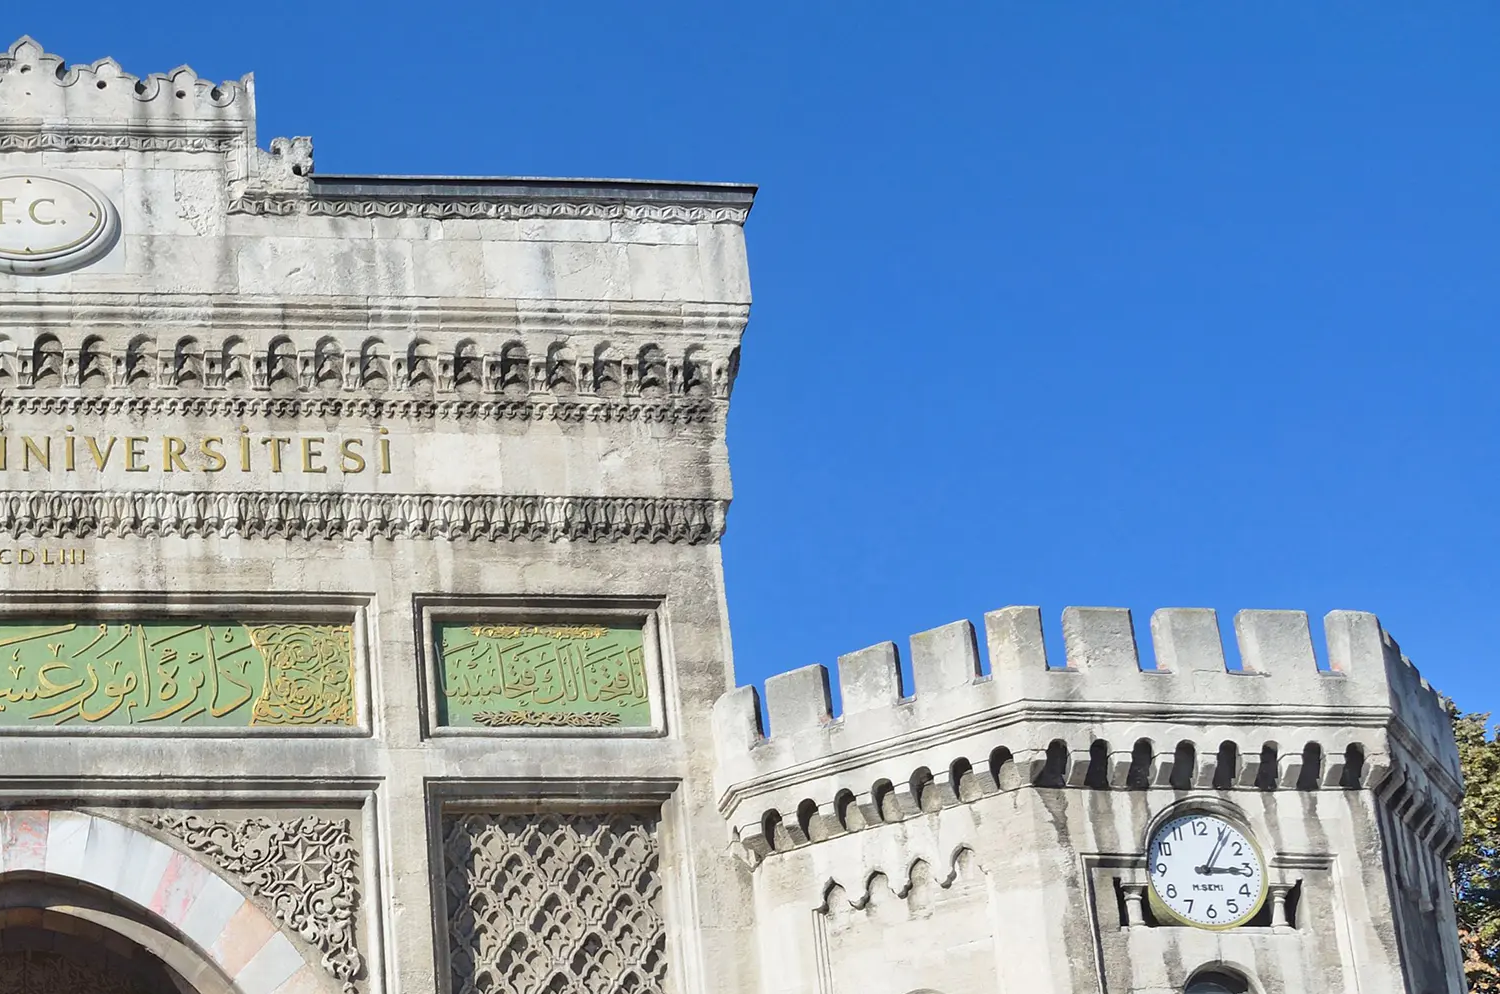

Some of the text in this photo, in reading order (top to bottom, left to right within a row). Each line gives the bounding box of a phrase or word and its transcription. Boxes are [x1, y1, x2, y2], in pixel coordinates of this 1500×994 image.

[1172, 826, 1183, 841] 11
[1191, 821, 1208, 836] 12
[1158, 841, 1172, 856] 10
[1231, 841, 1243, 856] 2
[1156, 863, 1168, 878] 9
[1241, 862, 1253, 878] 3
[1166, 883, 1177, 899] 8
[1238, 883, 1251, 897] 4
[1183, 899, 1194, 914] 7
[1206, 904, 1217, 919] 6
[1226, 899, 1239, 914] 5
